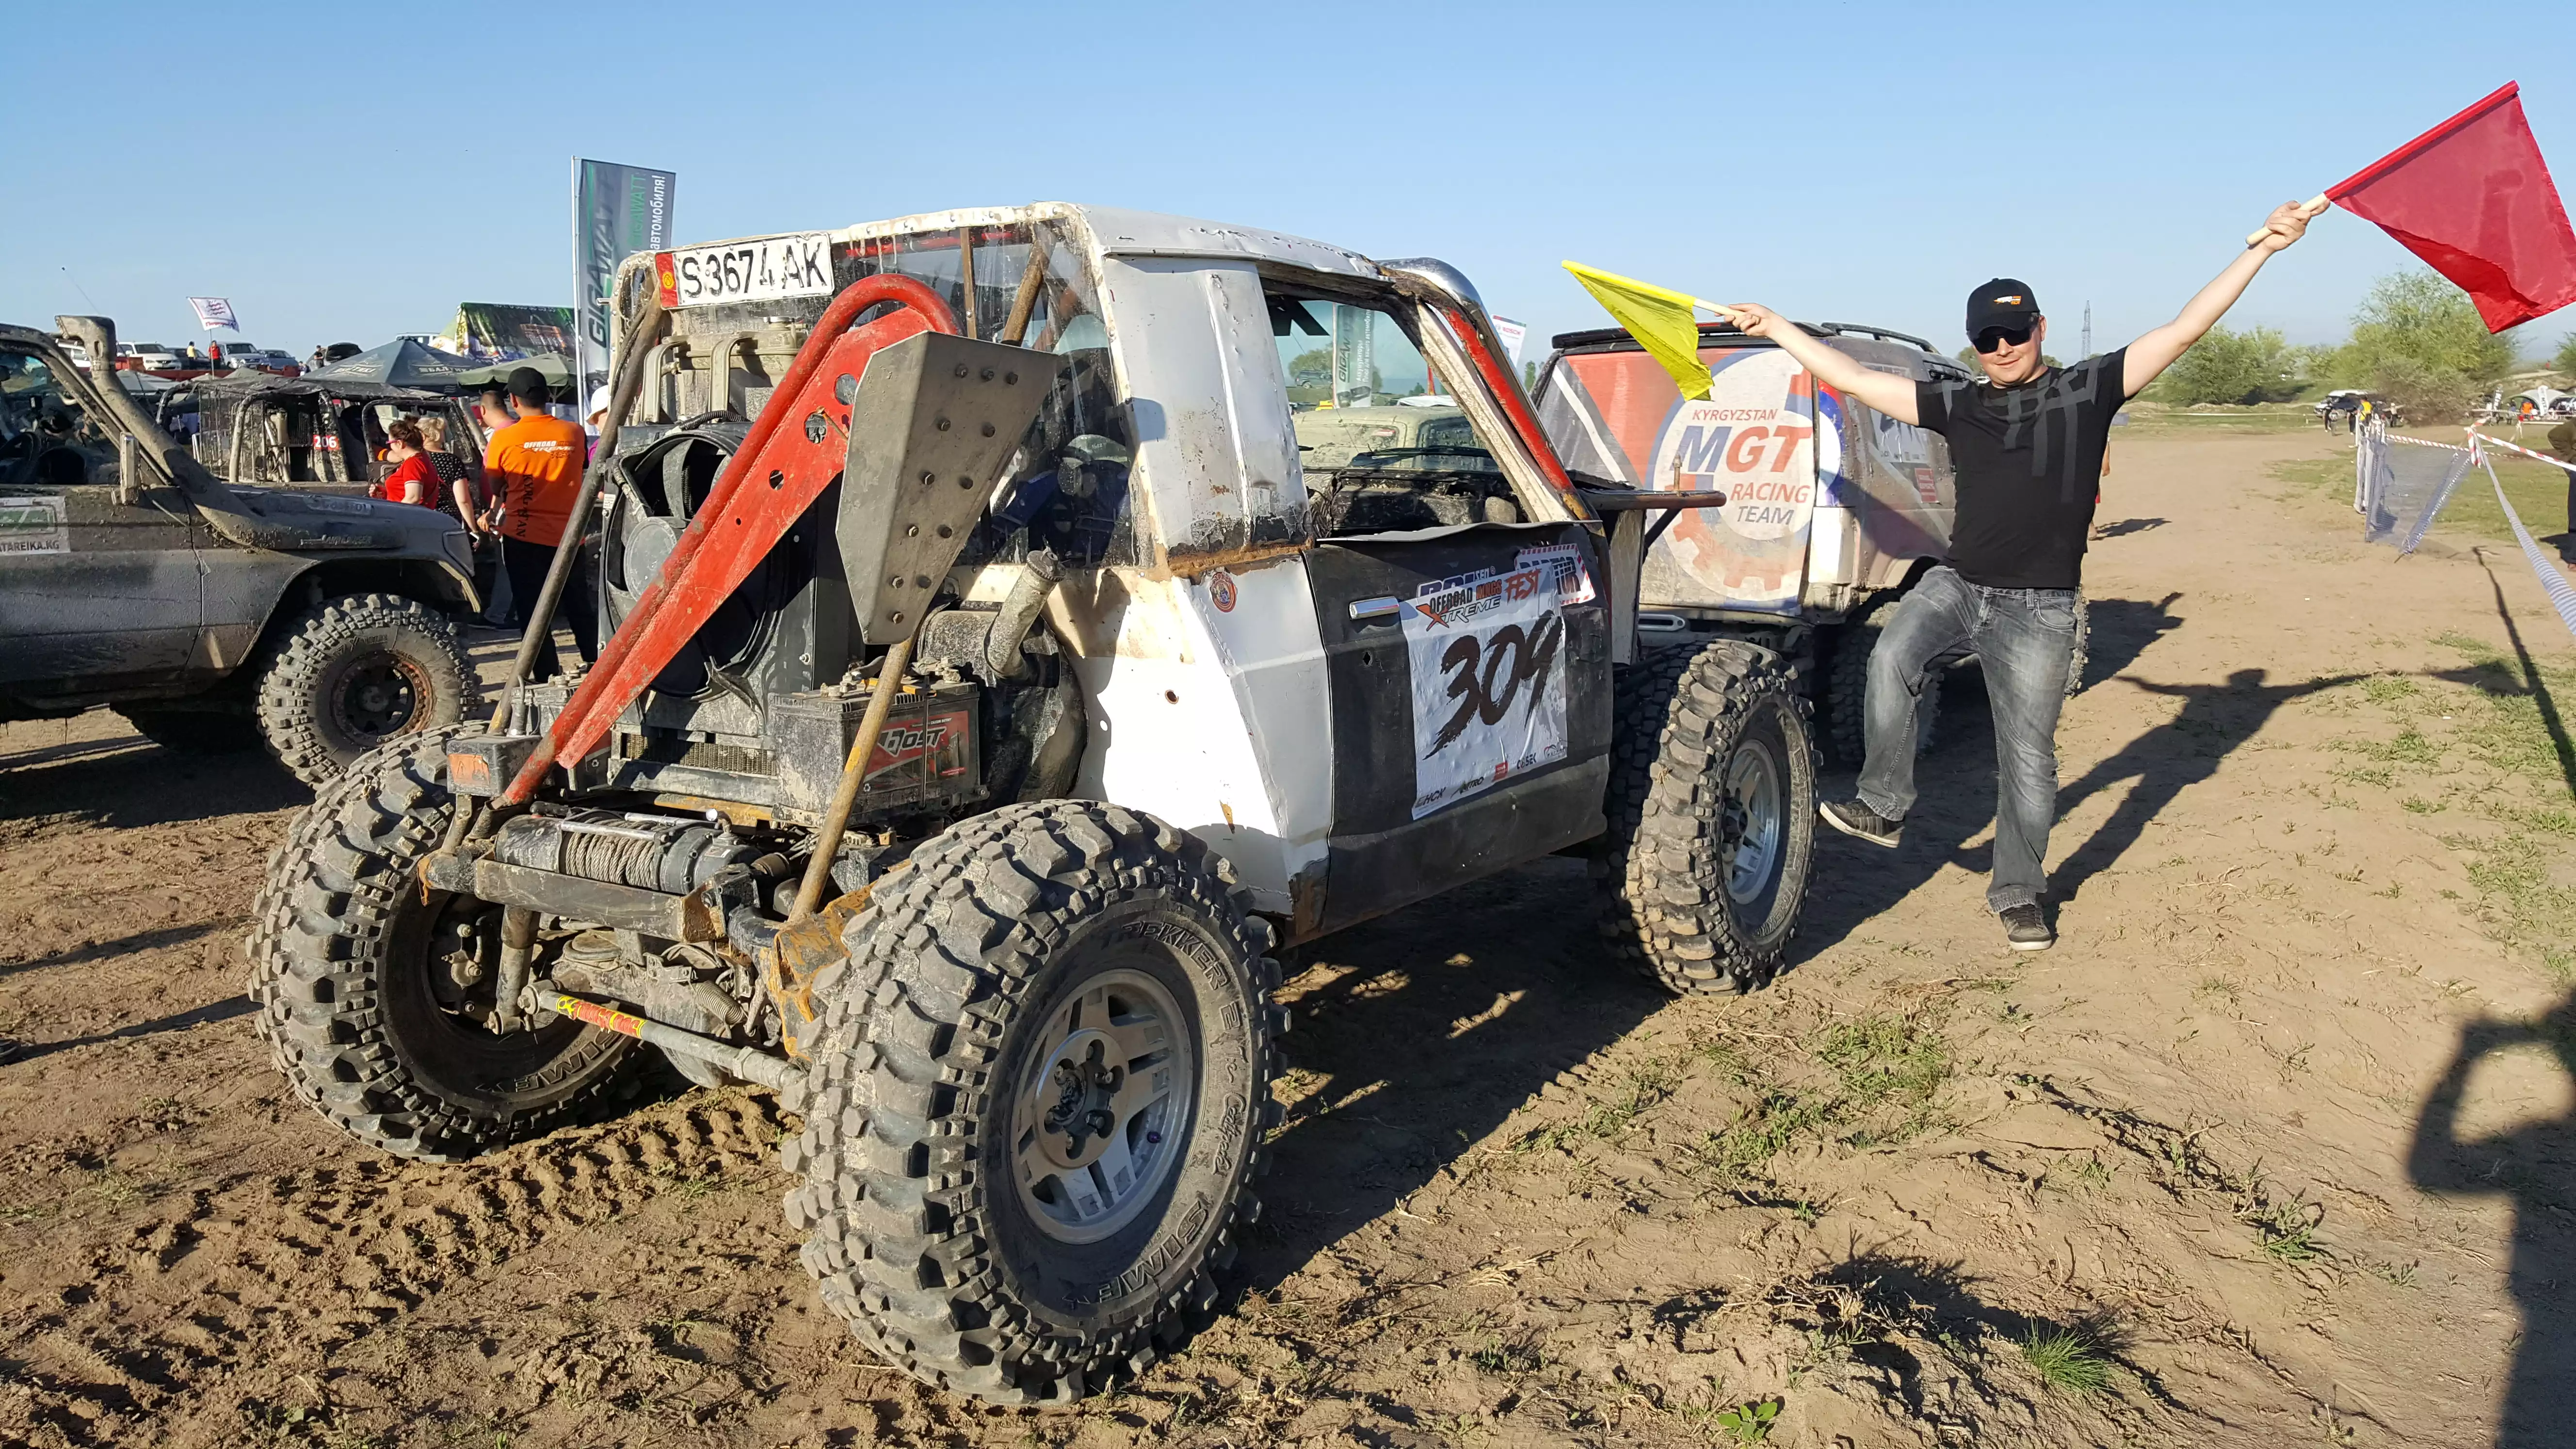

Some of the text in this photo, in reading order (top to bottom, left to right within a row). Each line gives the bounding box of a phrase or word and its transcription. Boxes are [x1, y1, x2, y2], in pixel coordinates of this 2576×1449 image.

[681, 242, 828, 298] S 3674 AK
[1692, 409, 1778, 421] KYRGYZSTAN
[314, 436, 338, 448] 206
[1670, 425, 1813, 473] MGT
[1730, 483, 1810, 503] RACING
[1737, 506, 1794, 525] TEAM
[1430, 587, 1473, 613] OFFROAD
[1504, 568, 1542, 605] FEST
[1416, 596, 1502, 631] XTREME
[1422, 610, 1563, 760] 309
